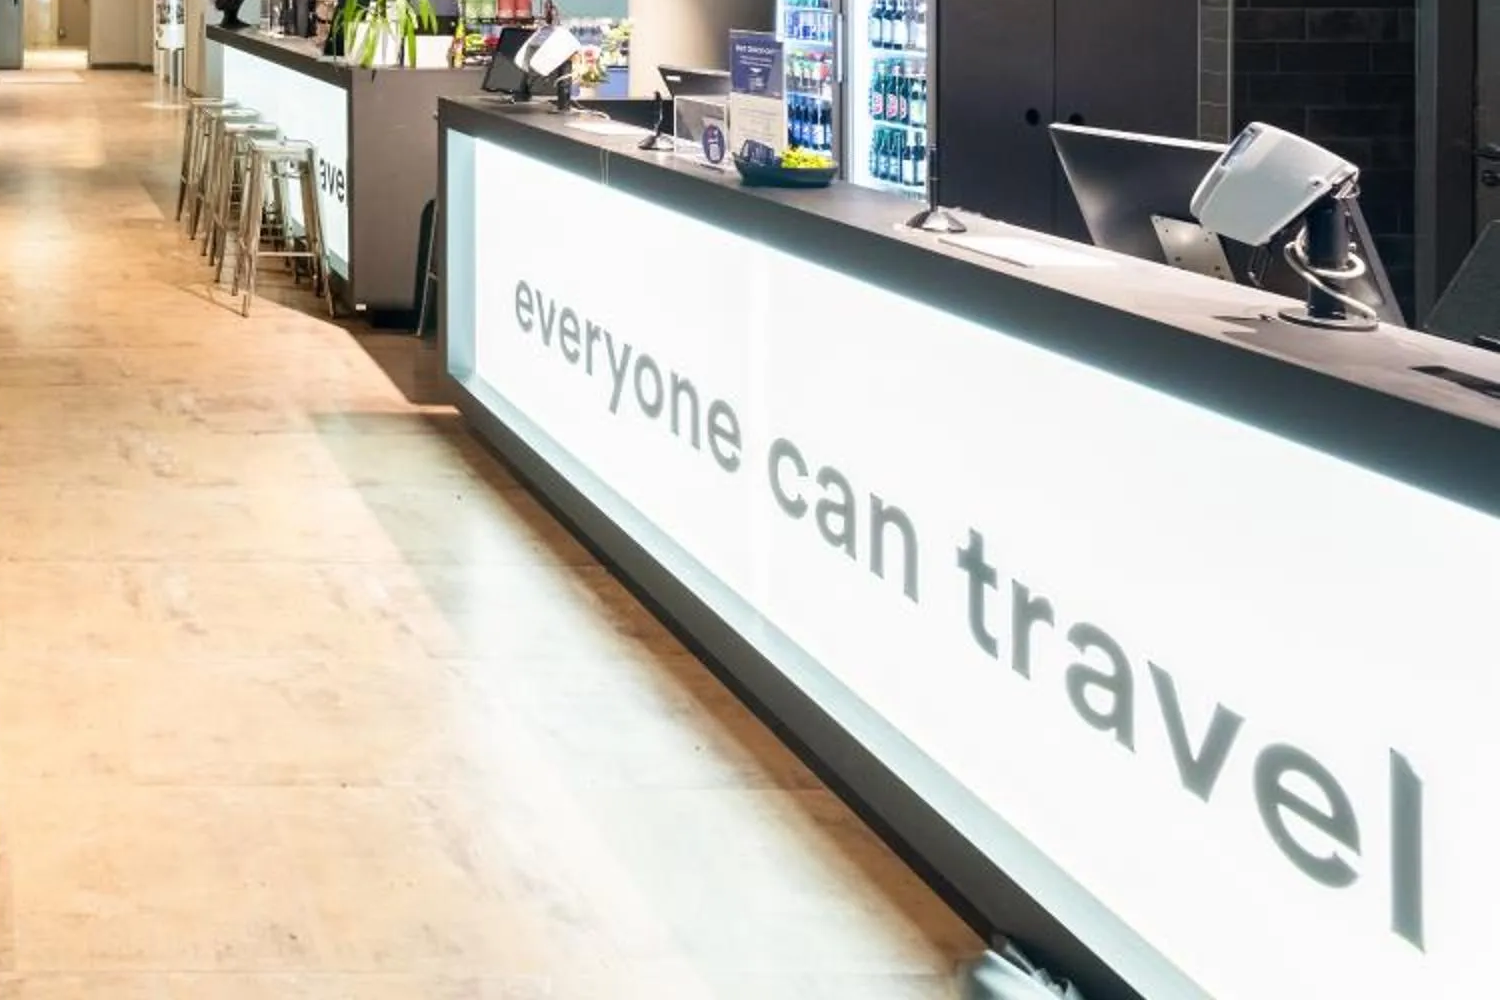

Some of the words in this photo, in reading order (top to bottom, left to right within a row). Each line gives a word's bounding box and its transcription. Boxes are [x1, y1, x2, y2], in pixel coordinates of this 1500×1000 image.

[514, 278, 743, 474] everyone
[767, 437, 920, 604] can
[956, 527, 1426, 954] travel
